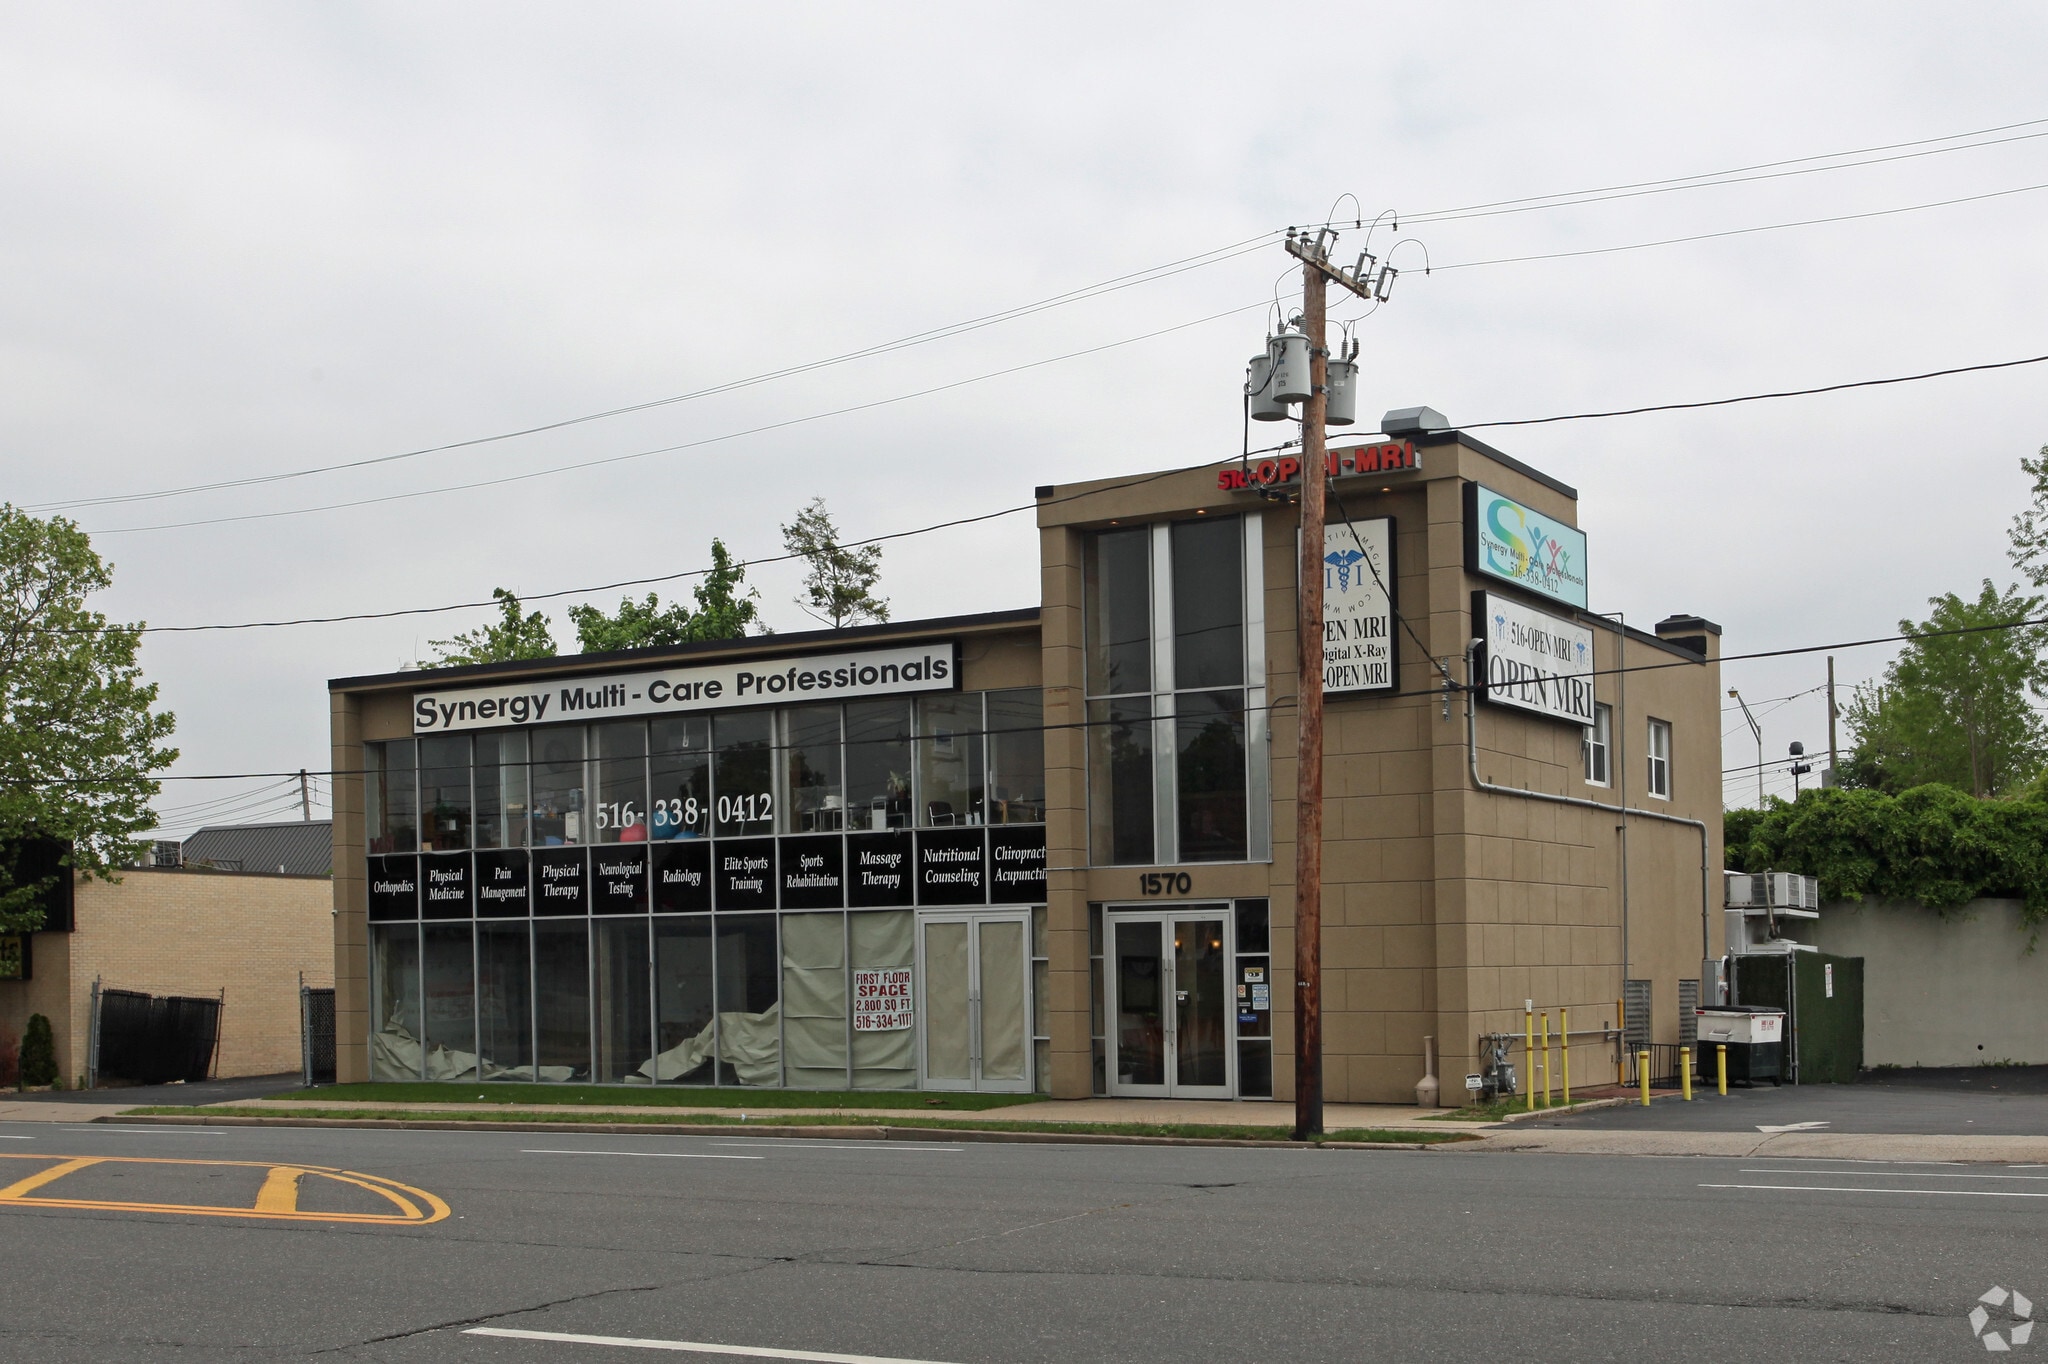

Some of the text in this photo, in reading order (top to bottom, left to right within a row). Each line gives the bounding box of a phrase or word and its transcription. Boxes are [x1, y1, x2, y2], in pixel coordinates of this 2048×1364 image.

[1480, 531, 1508, 557] Synergy
[1510, 561, 1559, 594] 516-338-0412
[1322, 615, 1387, 642] EN MRI
[1511, 621, 1551, 658] 516-OPEN
[1553, 635, 1571, 662] MRI
[1322, 643, 1388, 664] igital X-Ray
[1322, 661, 1388, 688] -OPEN MRI
[416, 693, 551, 728] Synergy
[736, 655, 949, 697] Professionals
[1489, 654, 1593, 719] OPEN MRI
[717, 792, 773, 824] 0412
[800, 853, 824, 872] Sports
[859, 851, 902, 868] Massage
[923, 845, 981, 863] Nutritional
[494, 866, 512, 880] Pain
[542, 863, 580, 881] Physical
[599, 860, 643, 879] Neurological
[724, 855, 769, 874] Elite Sports
[429, 867, 464, 885] Physical
[662, 868, 702, 887] Radiology
[730, 876, 764, 894] Training
[786, 872, 839, 889] Rehabilitation
[861, 871, 901, 889] Therapy
[925, 867, 981, 887] Counseling
[1139, 871, 1192, 895] 1570
[373, 879, 415, 896] Orthopedics
[429, 887, 465, 901] Medicine
[481, 885, 527, 902] Management
[543, 883, 579, 900] Therapy
[608, 881, 634, 898] Testing
[856, 971, 910, 985] FIRST FLOOR
[858, 984, 908, 997] SPACE
[856, 998, 911, 1012] 2,800 SQ FT
[856, 1013, 912, 1029] 516-334-1111
